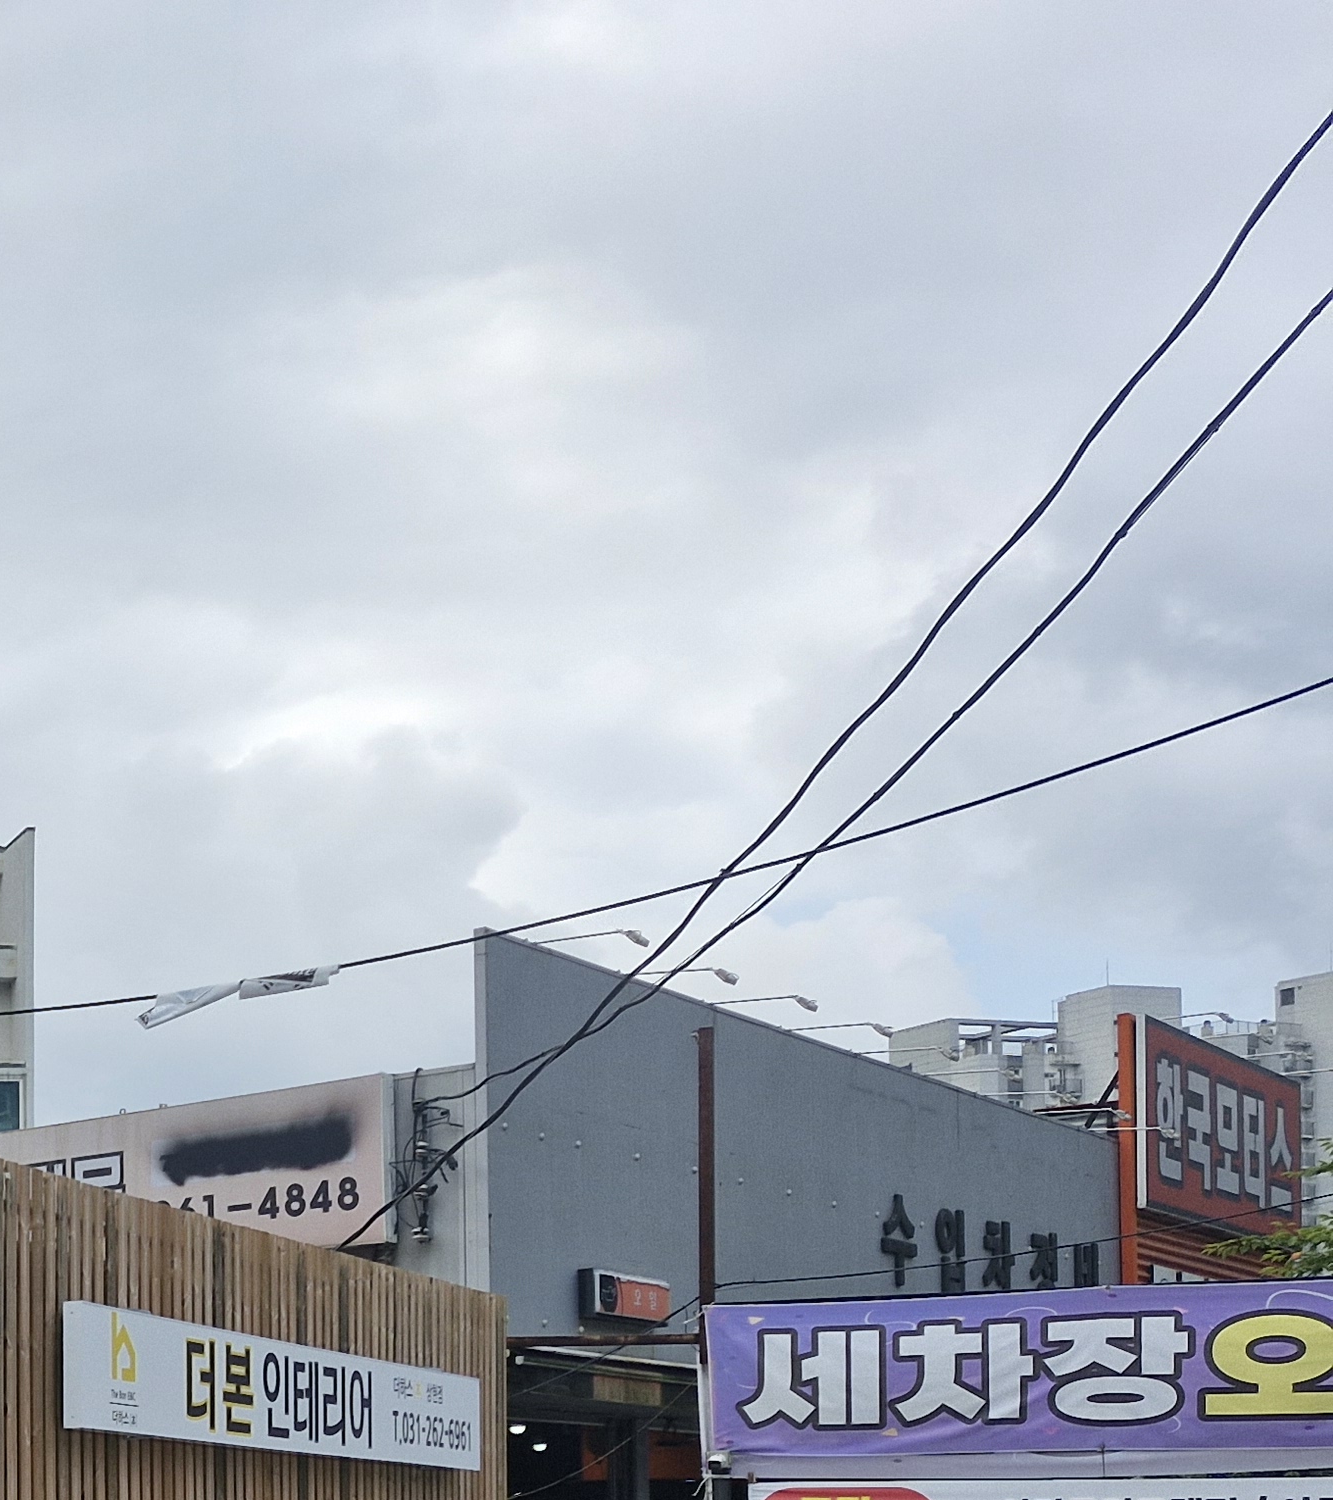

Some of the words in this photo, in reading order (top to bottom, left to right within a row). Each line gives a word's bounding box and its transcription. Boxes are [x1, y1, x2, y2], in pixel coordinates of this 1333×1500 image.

[1155, 1053, 1294, 1214] 한국모터스
[185, 1337, 253, 1438] 더본
[262, 1352, 373, 1449] 인테리어
[392, 1410, 471, 1451] T.031-262-6961
